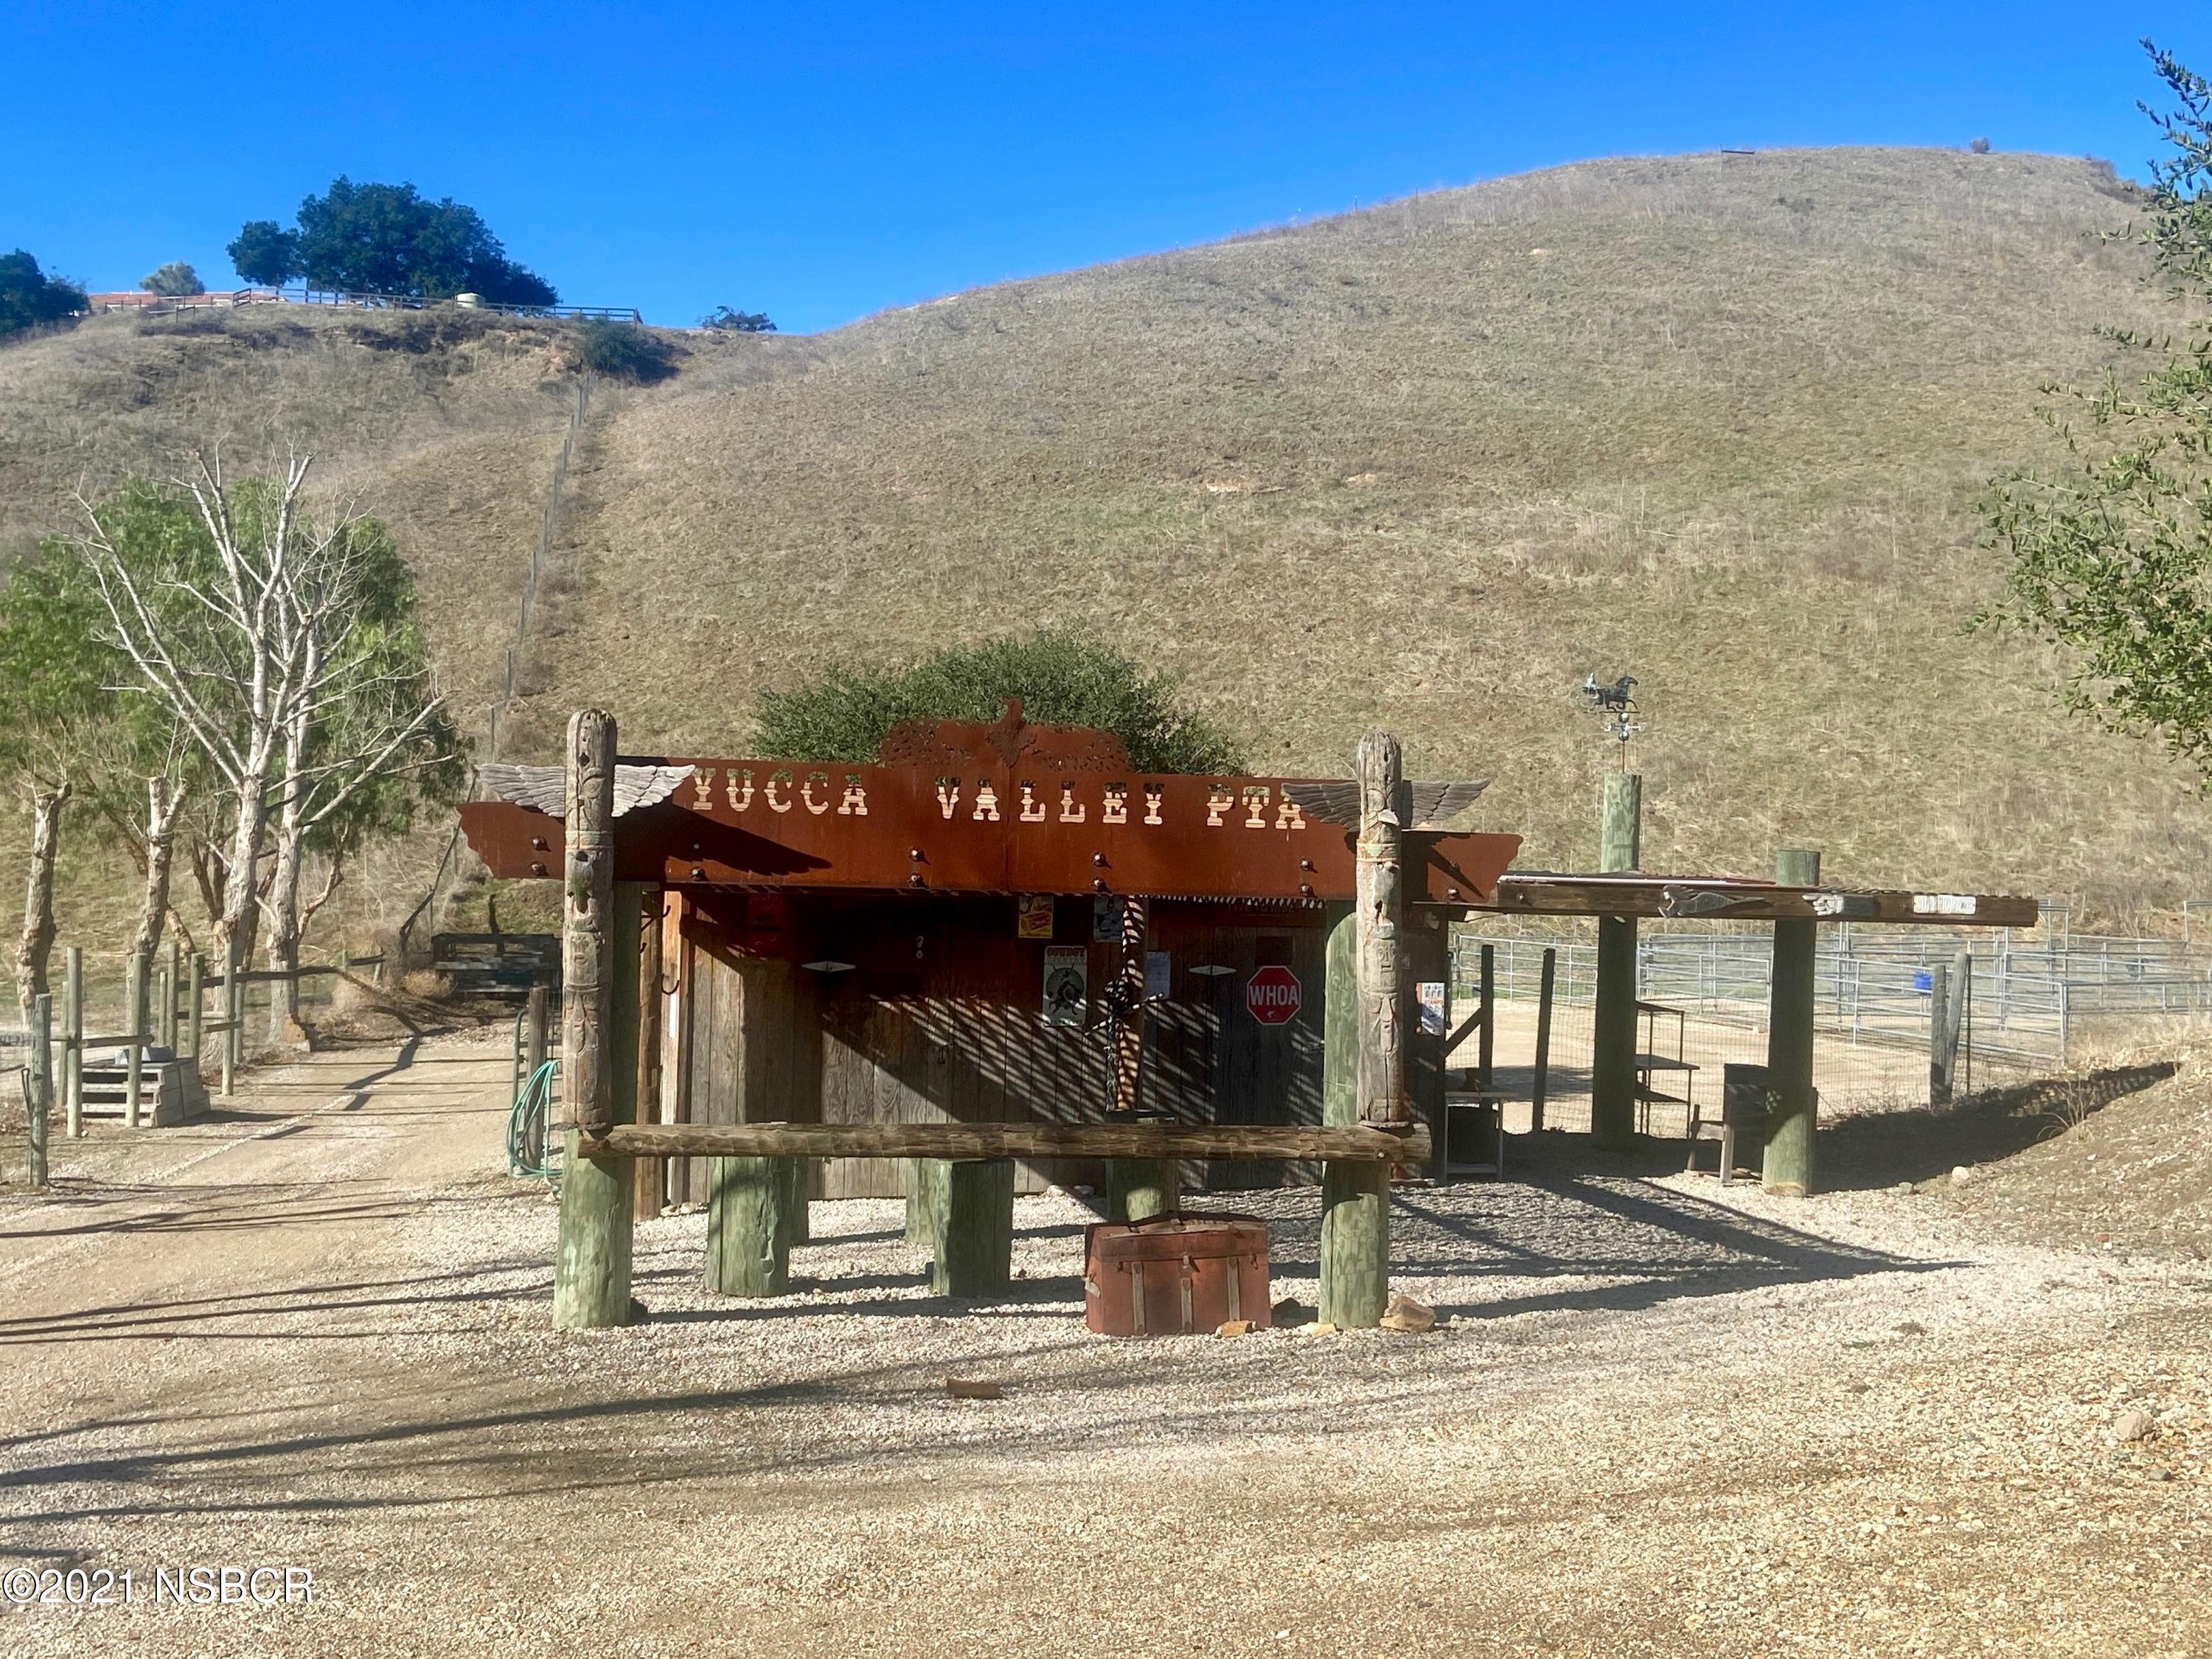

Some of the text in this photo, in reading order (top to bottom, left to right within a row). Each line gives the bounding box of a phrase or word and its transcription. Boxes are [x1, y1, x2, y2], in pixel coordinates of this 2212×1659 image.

[692, 768, 1306, 830] YUCCA VALLEY PTA
[1249, 984, 1299, 1006] WHOA
